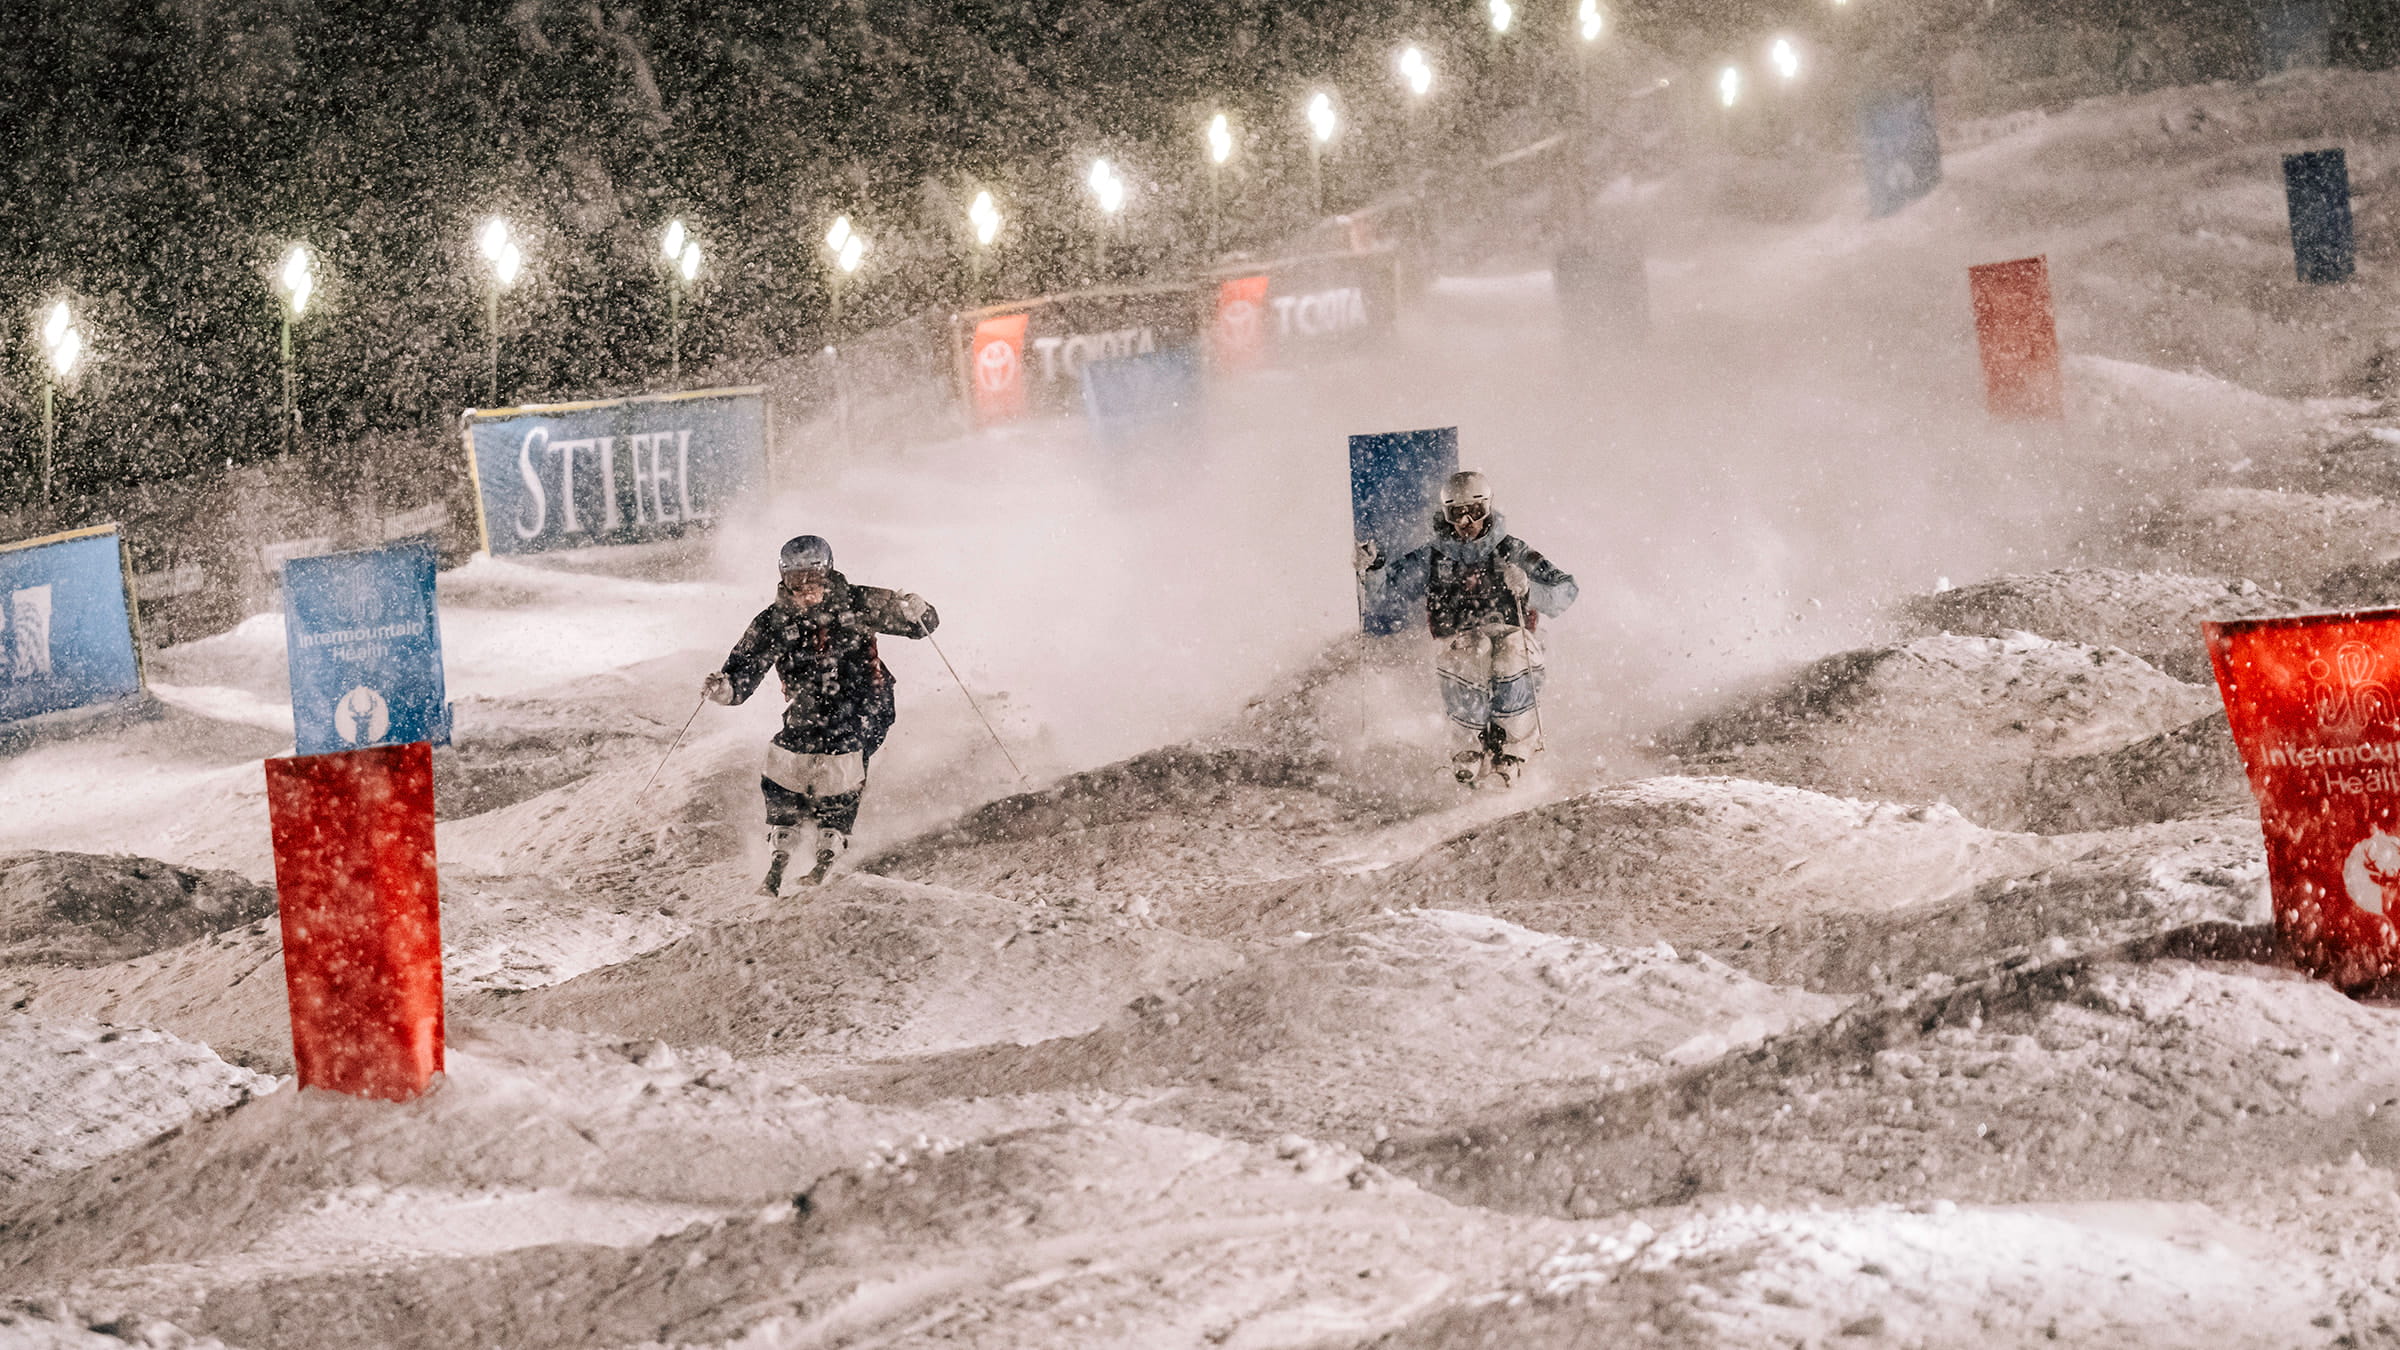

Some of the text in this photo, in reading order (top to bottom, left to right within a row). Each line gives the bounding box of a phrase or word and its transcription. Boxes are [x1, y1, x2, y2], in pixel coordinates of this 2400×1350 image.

[515, 426, 713, 539] STIFEL
[299, 620, 423, 649] Intermountain
[332, 641, 389, 662] Health
